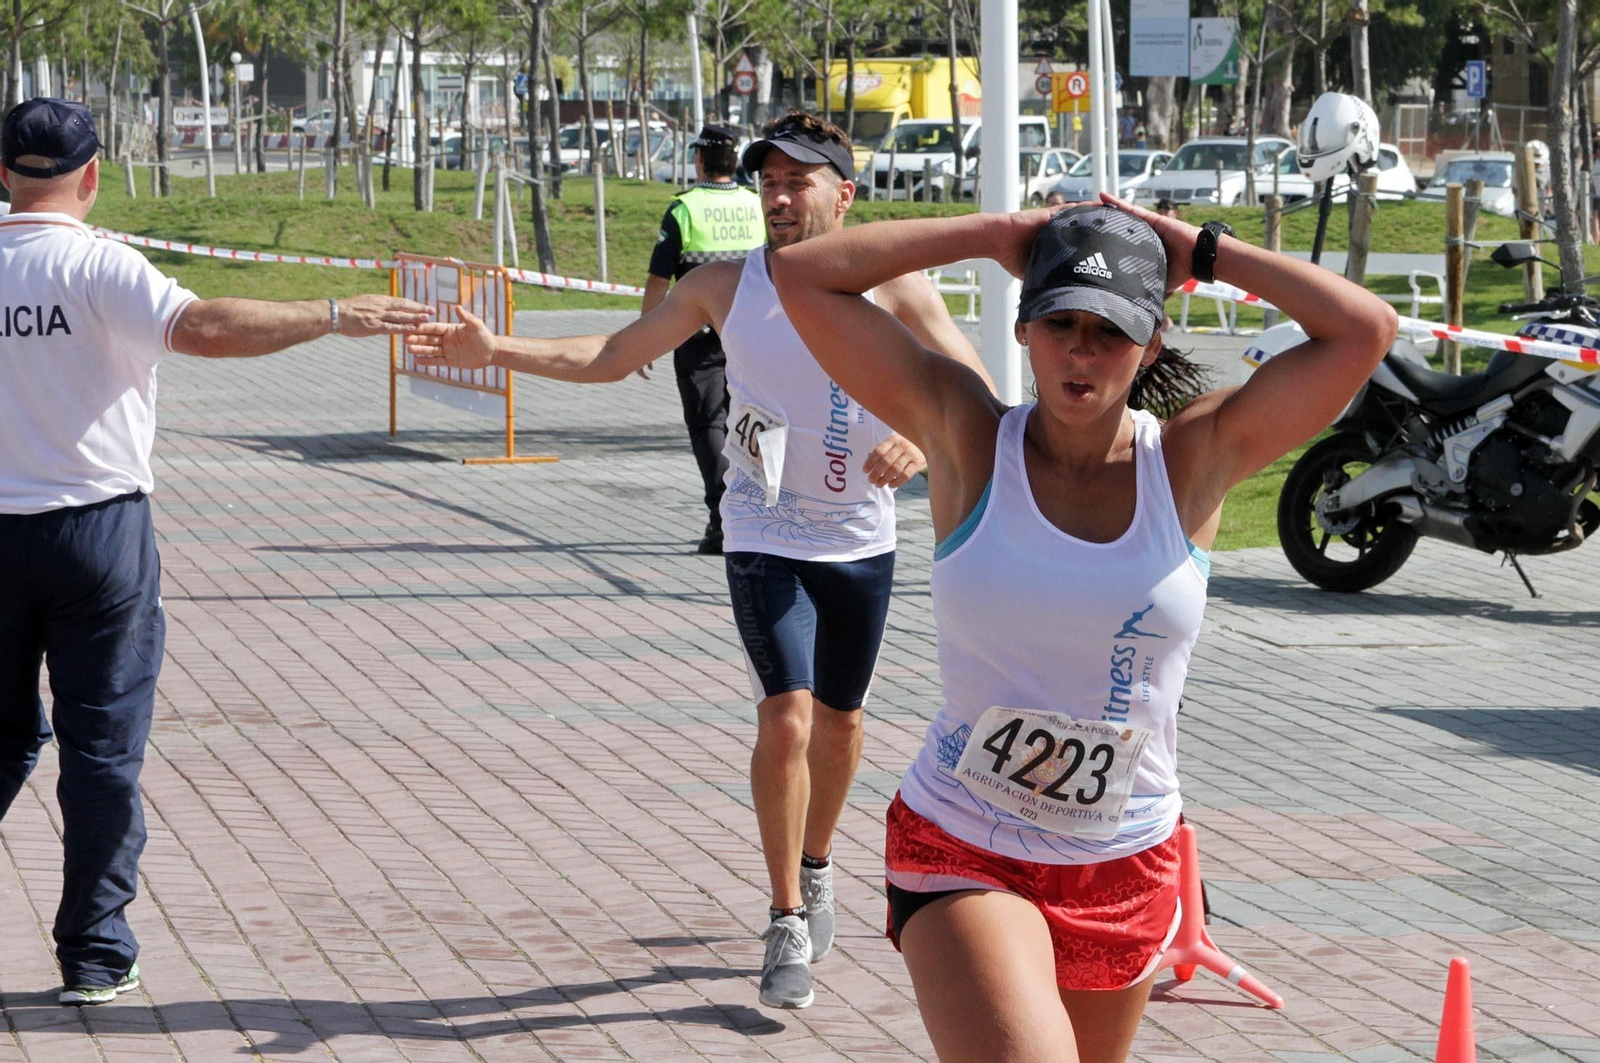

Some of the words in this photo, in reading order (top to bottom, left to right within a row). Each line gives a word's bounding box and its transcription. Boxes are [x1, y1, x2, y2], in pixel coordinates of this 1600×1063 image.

[1469, 66, 1480, 93] P
[703, 207, 758, 223] POLICIA
[712, 225, 753, 241] LOCAL
[1073, 265, 1113, 279] adidas
[0, 305, 72, 337] ICIA
[1142, 655, 1154, 703] LIFESTYLE
[982, 717, 1115, 805] 4223
[1019, 806, 1038, 821] 4223
[1039, 801, 1103, 822] DEPORTIVA
